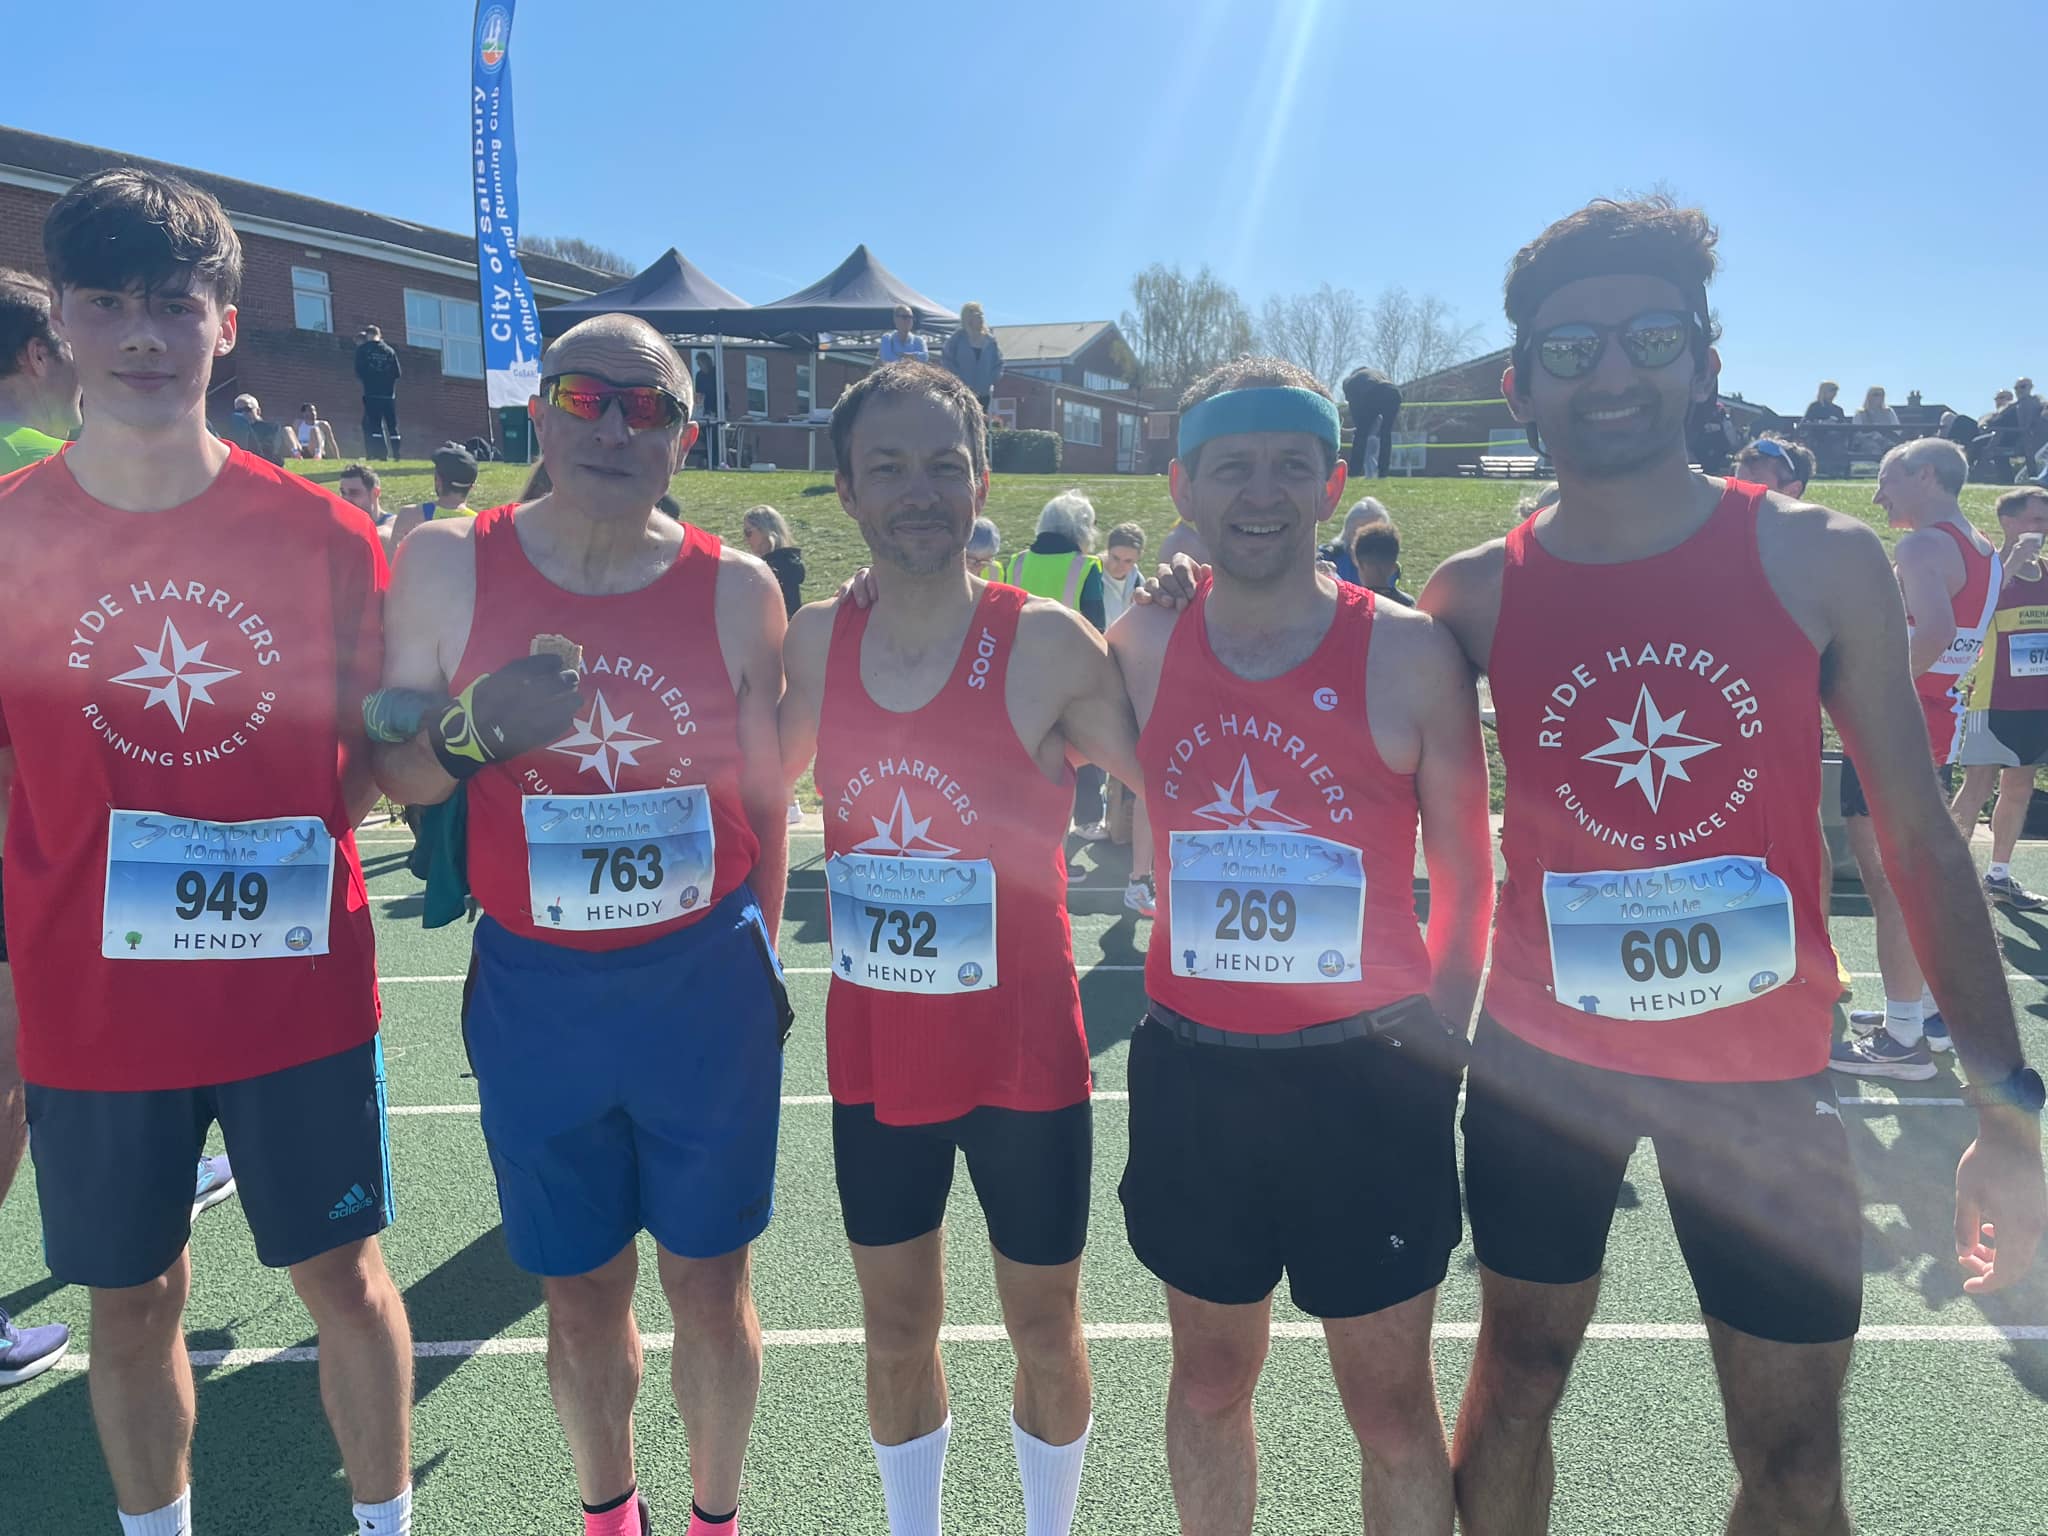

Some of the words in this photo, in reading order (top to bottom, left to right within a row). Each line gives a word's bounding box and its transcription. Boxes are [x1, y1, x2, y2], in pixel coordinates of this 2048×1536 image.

[489, 86, 500, 131] Club
[474, 85, 492, 234] Salisbury
[491, 139, 509, 219] Running
[484, 241, 503, 275] of
[500, 226, 516, 258] and
[491, 284, 511, 342] City
[69, 594, 123, 669] RYDE
[130, 579, 280, 666] HARRIERS
[968, 627, 997, 690] soar
[1539, 664, 1597, 749] RYDE
[1606, 642, 1762, 738] HARRIERS
[82, 703, 174, 766] RUNNING
[183, 731, 247, 766] SINCE
[245, 690, 276, 732] 1886
[838, 767, 874, 823] RYDE
[878, 758, 977, 826] HARRIERS
[1165, 723, 1211, 799] RYDE
[1220, 714, 1352, 823] HARRIERS
[541, 796, 693, 832] Salisbury
[1555, 783, 1645, 850] RUNNING
[1655, 813, 1727, 851] SINCE
[1725, 767, 1758, 813] 1886
[130, 817, 315, 863] Salisbury
[1183, 836, 1343, 881] Salisbury
[582, 844, 664, 894] 763
[837, 858, 976, 902] Salisbury
[1565, 863, 1762, 912] Salisbury
[175, 871, 268, 920] 949
[587, 900, 662, 921] HENDY
[1215, 888, 1297, 942] 269
[174, 933, 263, 950] HENDY
[865, 907, 938, 957] 732
[1621, 922, 1721, 983] 600
[868, 963, 937, 984] HENDY
[1216, 953, 1295, 972] HENDY
[1630, 985, 1725, 1012] HENDY
[328, 1196, 373, 1220] adidas
